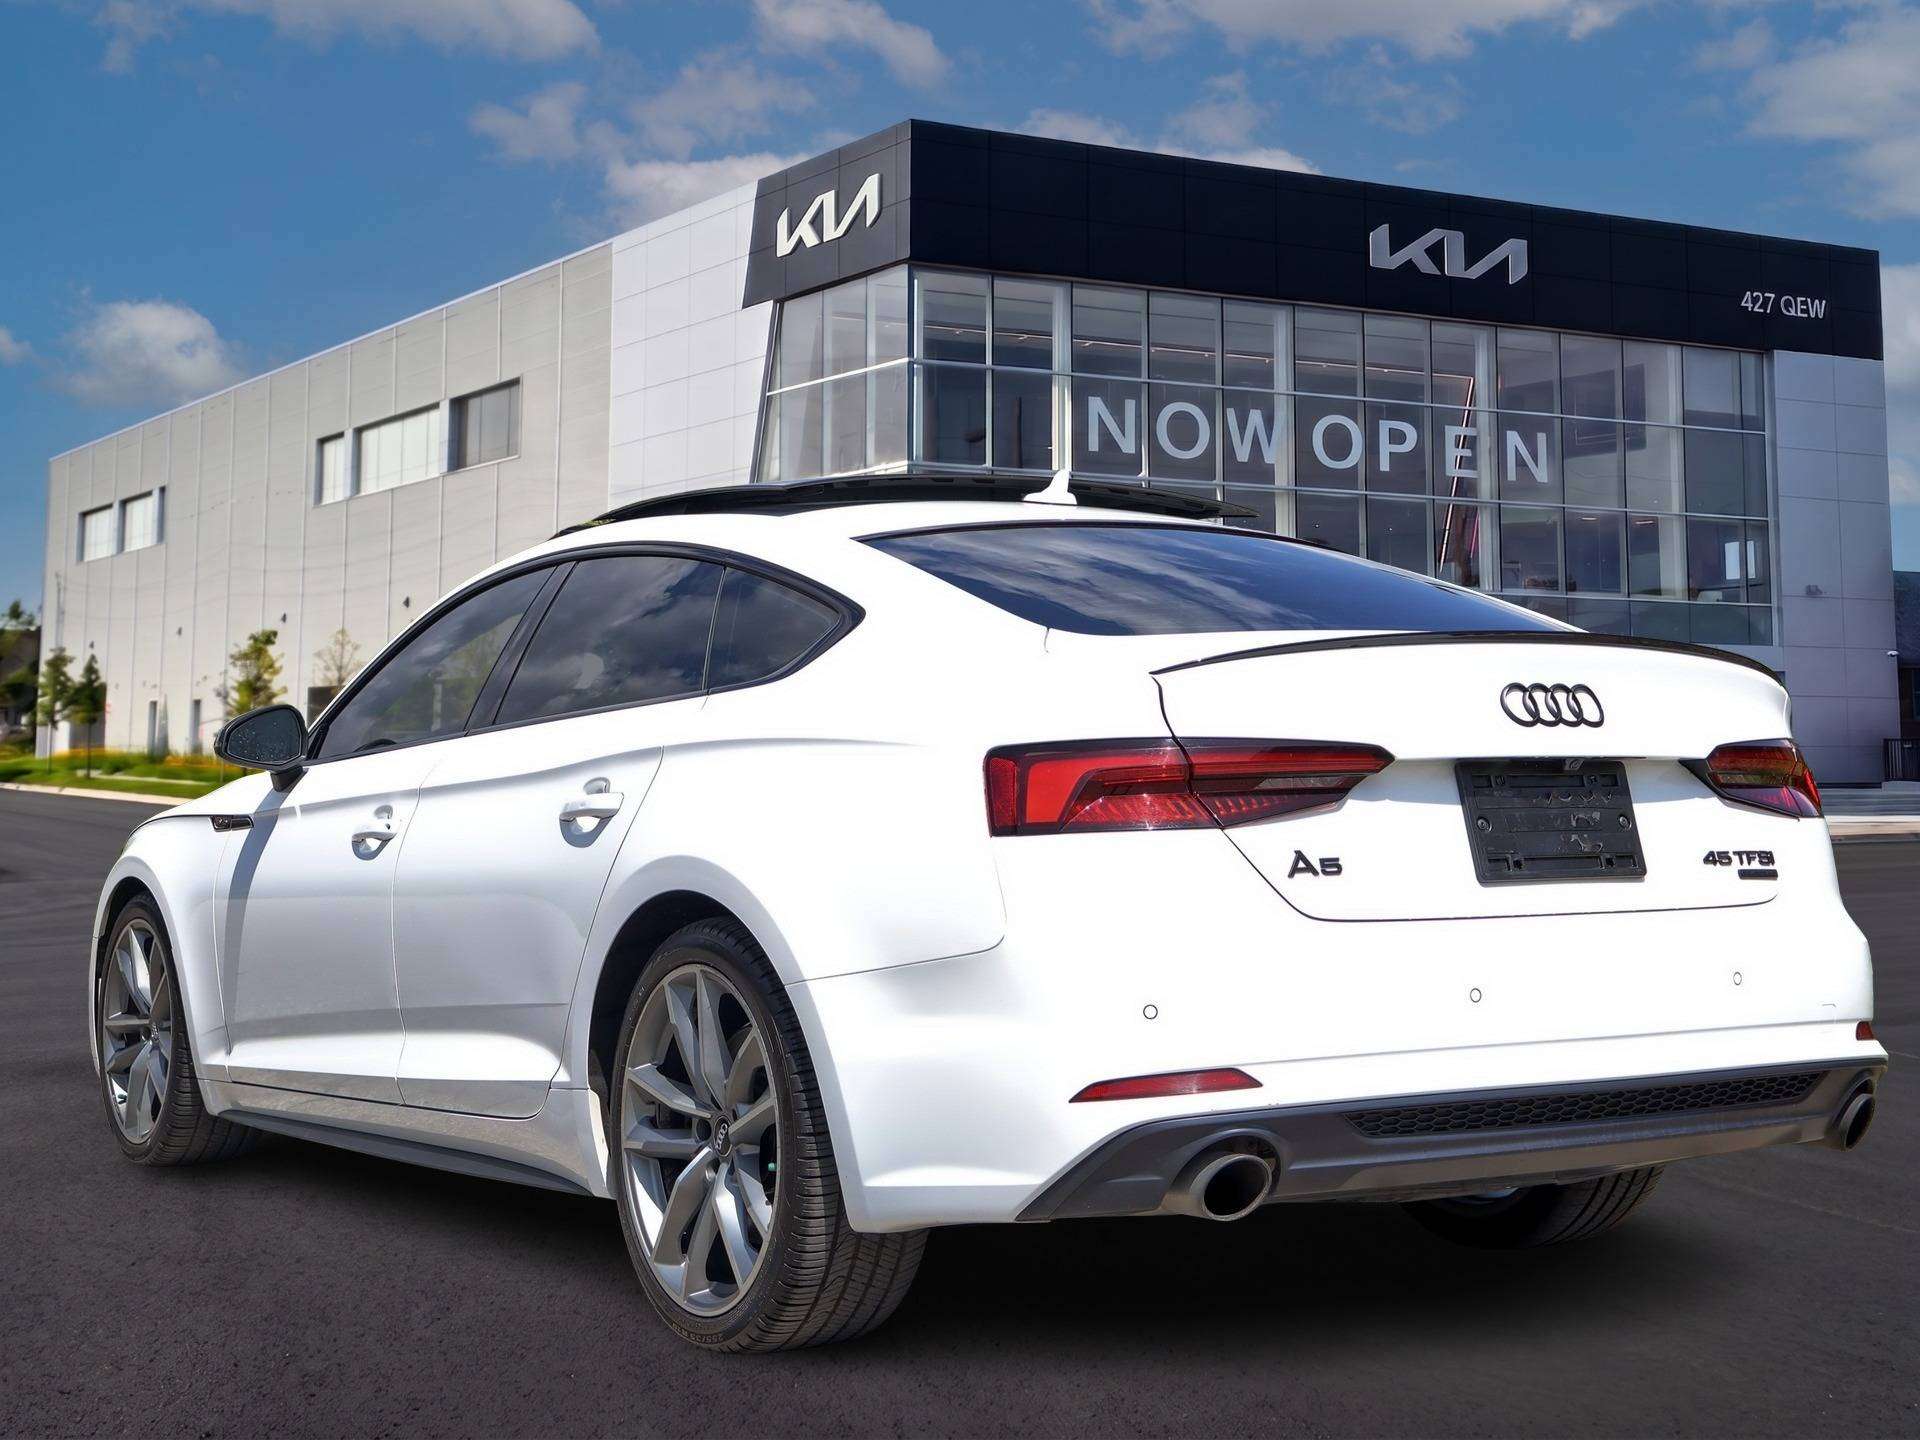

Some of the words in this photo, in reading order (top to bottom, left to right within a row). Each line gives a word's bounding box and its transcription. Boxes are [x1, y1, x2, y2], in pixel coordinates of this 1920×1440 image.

[776, 173, 881, 258] KIA
[1369, 223, 1528, 285] KIA
[1740, 291, 1776, 314] 427
[1780, 295, 1826, 319] QEW
[1087, 396, 1281, 465] NOW
[1311, 414, 1549, 483] OPEN
[1287, 849, 1343, 879] A5
[1702, 850, 1733, 867] 45
[1732, 850, 1775, 867] TFSI
